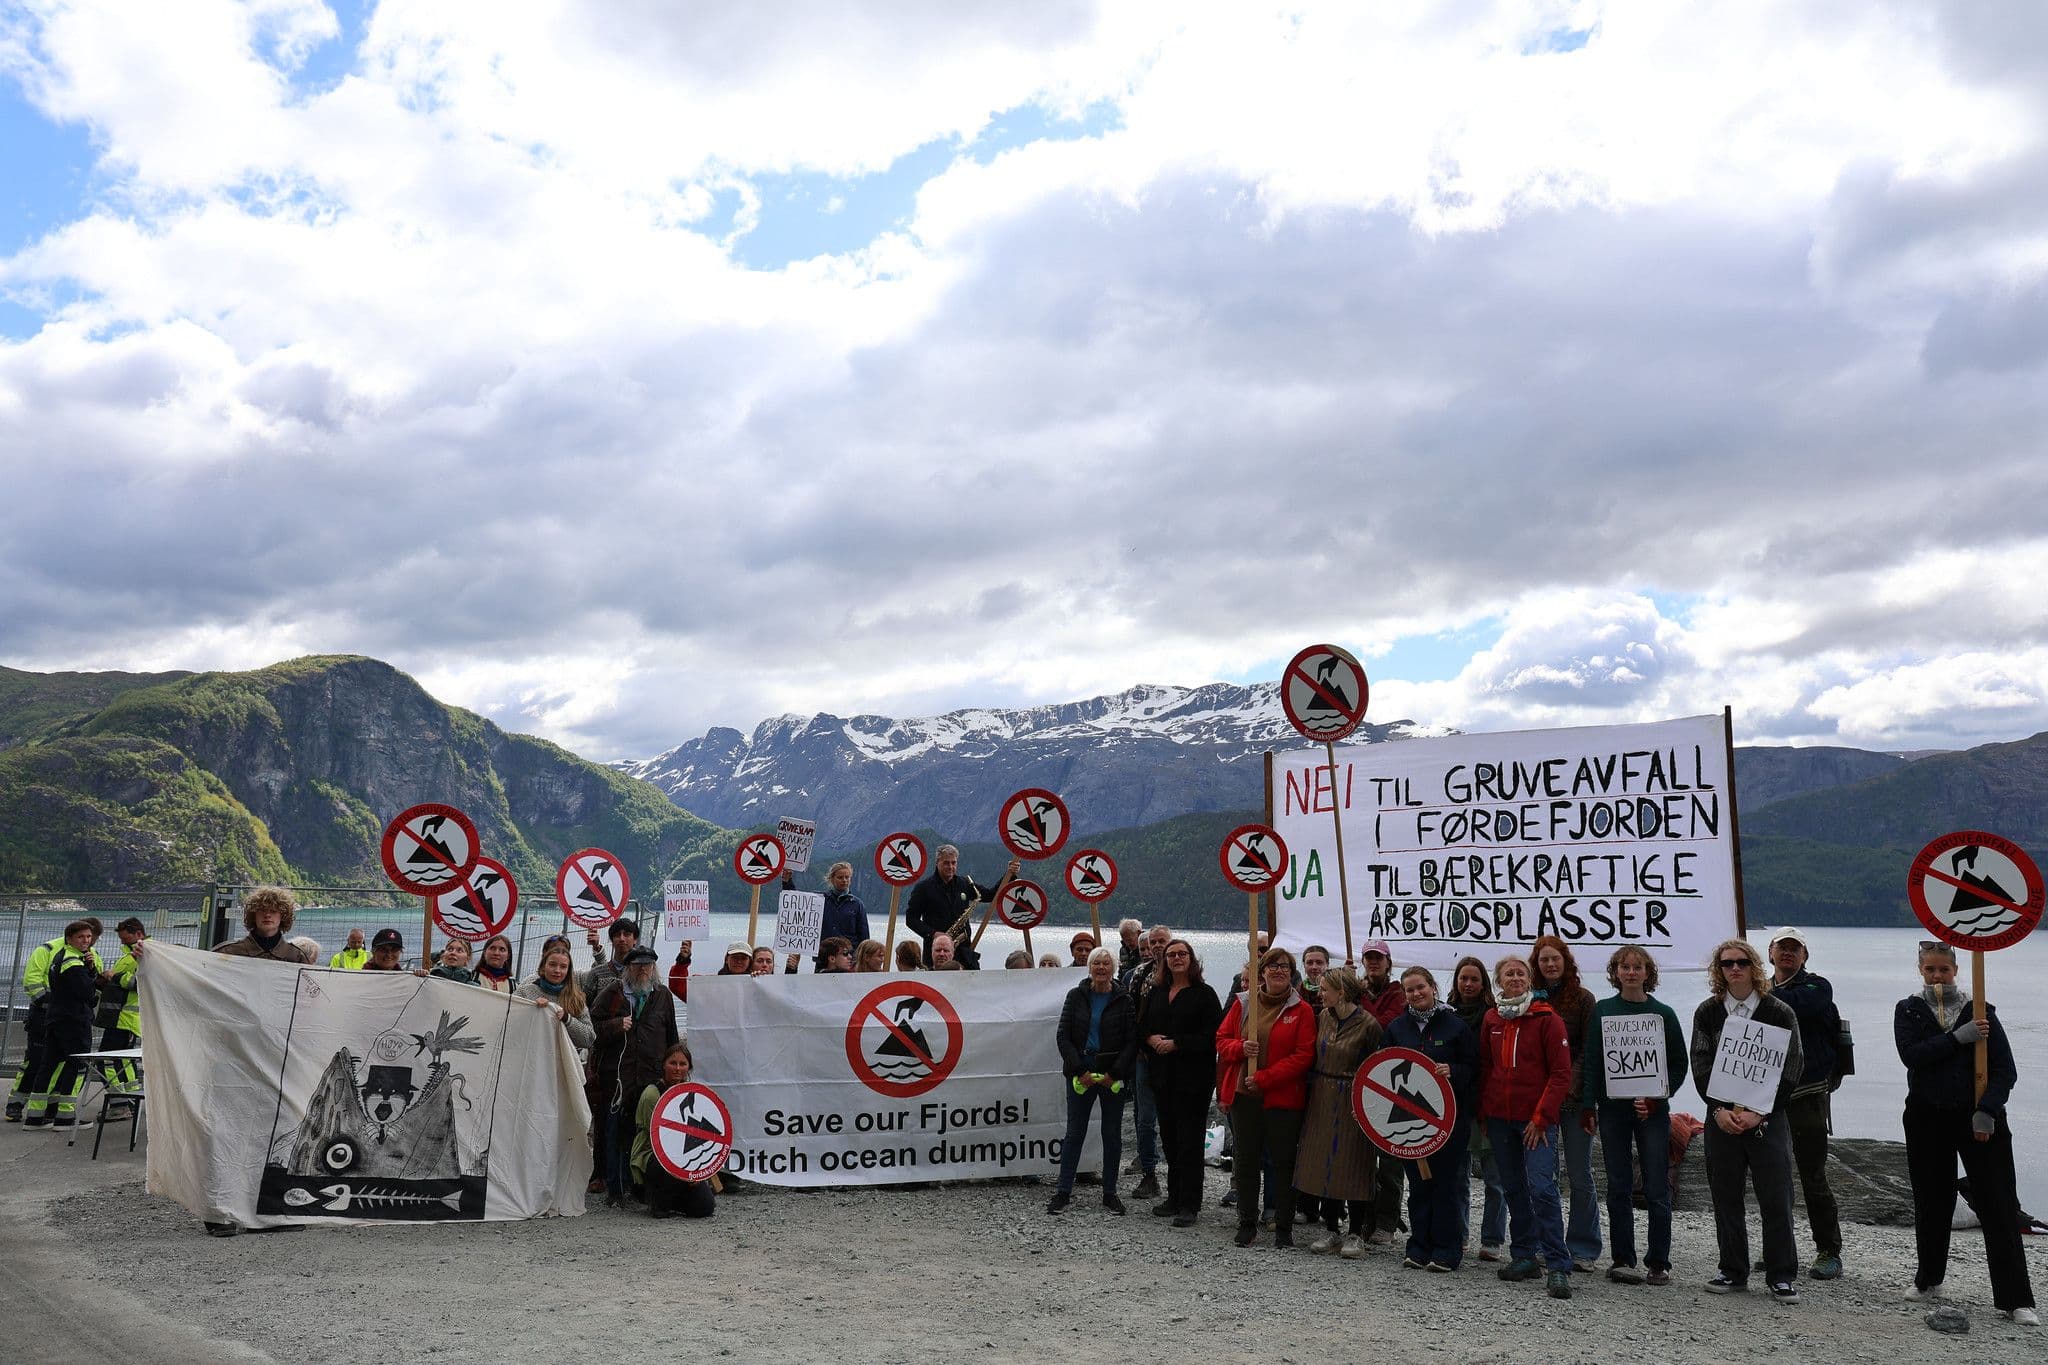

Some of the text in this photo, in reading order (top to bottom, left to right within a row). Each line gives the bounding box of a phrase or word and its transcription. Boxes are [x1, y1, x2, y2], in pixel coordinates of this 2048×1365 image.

[1304, 721, 1355, 740] fjordaksjonen.org
[1285, 744, 1714, 816] NEI TIL GRUVEAVFALL
[1375, 793, 1719, 848] I FØRDEFJORDEN
[1933, 833, 2018, 857] GRUVEAVFALL
[1282, 849, 1324, 900] JA
[1367, 865, 1412, 897] TIL
[1420, 853, 1698, 896] BÆREKRAFTIGE
[667, 898, 709, 912] INGENTING
[782, 893, 821, 911] GRUVE-
[668, 913, 674, 928] Å
[780, 909, 820, 927] SLAM ER
[1368, 898, 1671, 940] ARBEIDSPLASSER
[779, 936, 816, 950] SKAM
[780, 925, 819, 939] NOREGS
[1603, 1019, 1657, 1032] GRUVESLAM
[1743, 1023, 1764, 1043] LA
[1604, 1036, 1656, 1047] ER NOREGS
[1721, 1037, 1784, 1068] FJORDEN
[1607, 1049, 1659, 1075] SKAM
[1721, 1057, 1767, 1084] LEVE!
[764, 1099, 1029, 1136] Save our Fjords!
[725, 1134, 1064, 1174] Ditch ocean dumping
[1390, 1130, 1447, 1156] fjordaksjonen.org
[688, 1143, 730, 1180] fjordaksjonen.org
